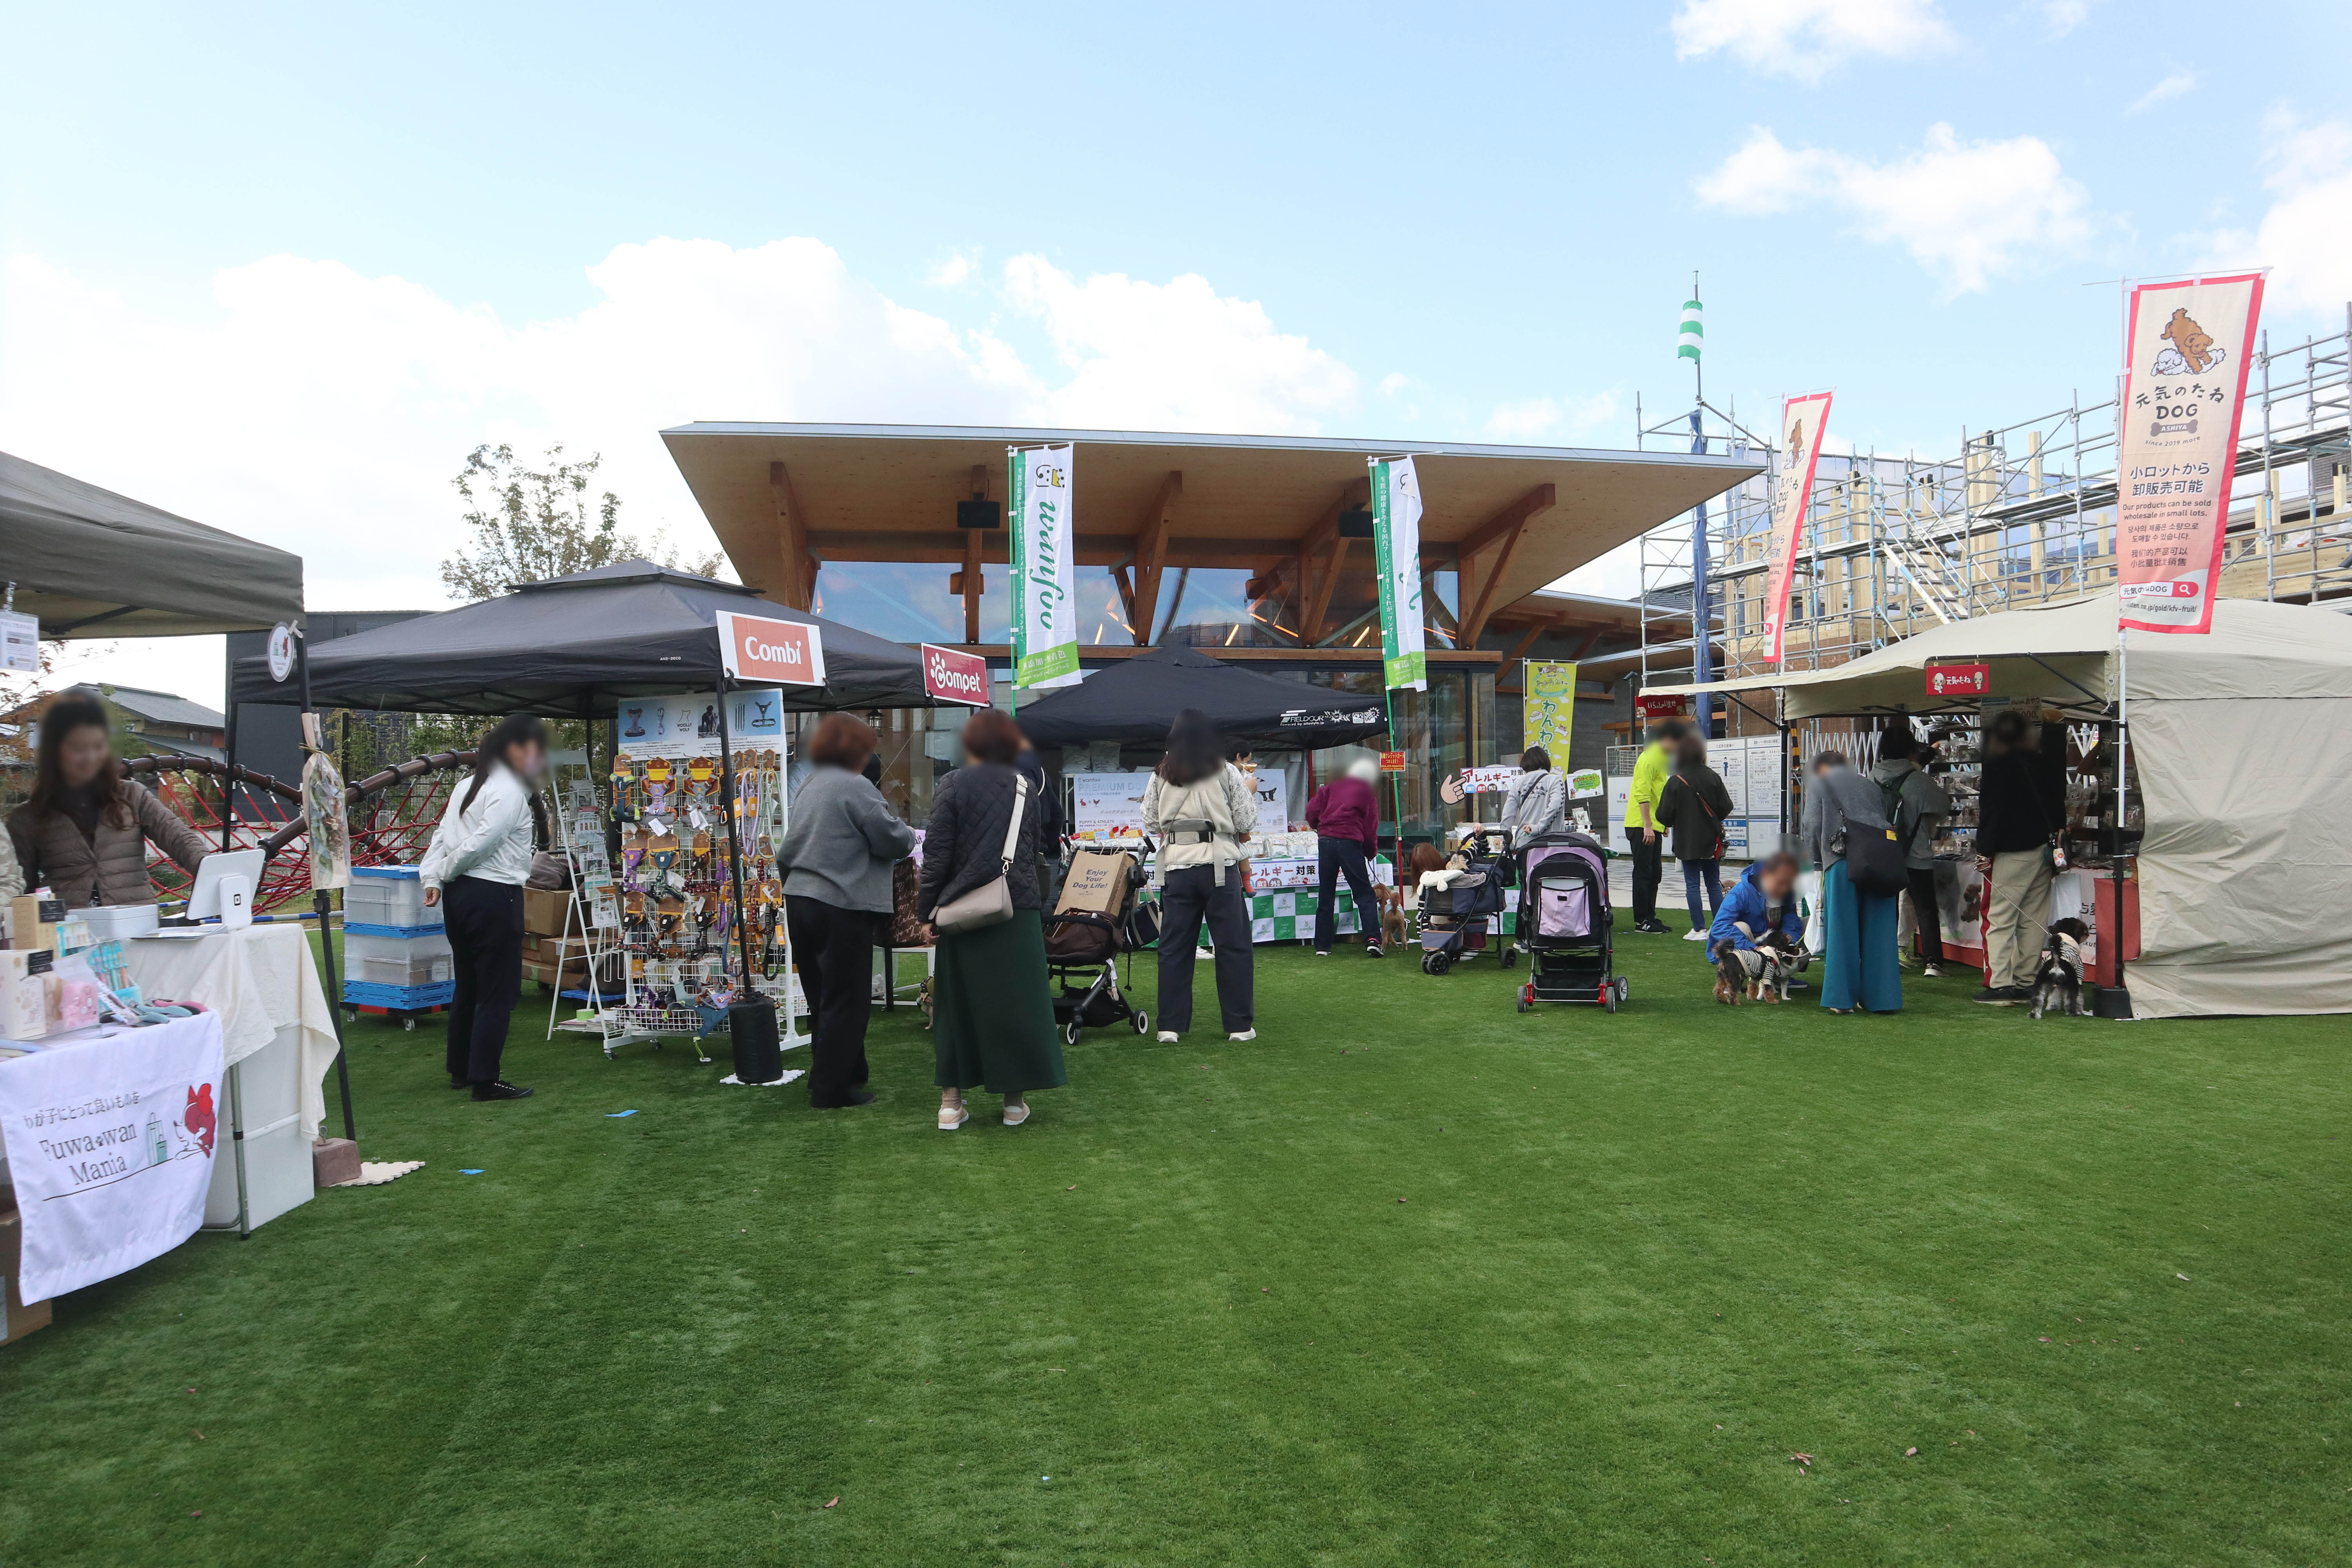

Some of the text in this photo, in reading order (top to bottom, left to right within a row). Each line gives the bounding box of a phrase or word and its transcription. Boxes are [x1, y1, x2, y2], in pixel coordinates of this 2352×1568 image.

[2136, 383, 2224, 409] 元気のたね
[2156, 404, 2198, 419] DOG
[2182, 436, 2201, 445] more
[2130, 462, 2210, 480] 小ロットから
[2132, 479, 2204, 497] 卸販売可能
[2136, 502, 2166, 511] products
[2131, 547, 2188, 558] 我们的产品可以
[1029, 501, 1064, 630] wanfoo
[745, 636, 802, 665] Combi
[1946, 675, 1971, 685] 元気のたね
[1462, 769, 1510, 783] アレルギー
[1079, 783, 1125, 791] PREMIUM
[69, 1152, 127, 1185] Mania
